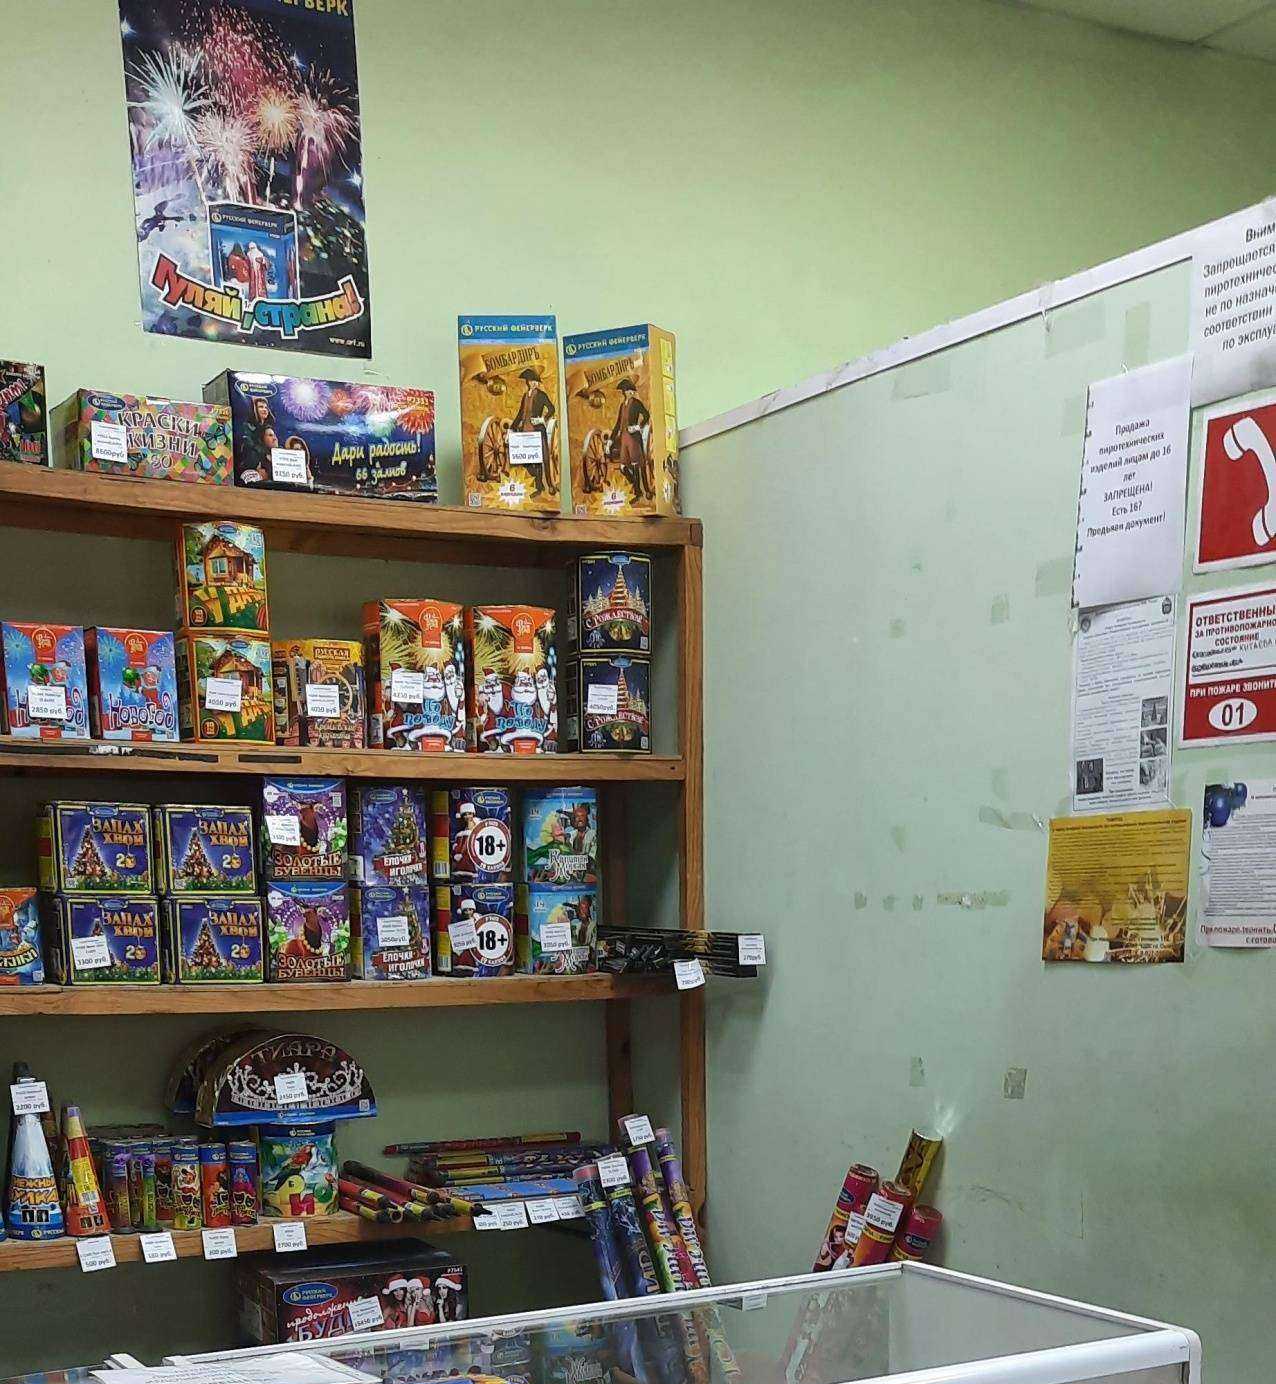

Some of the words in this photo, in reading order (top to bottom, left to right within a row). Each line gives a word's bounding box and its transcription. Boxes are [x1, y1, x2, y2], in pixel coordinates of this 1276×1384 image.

[1203, 244, 1276, 278] Запрещается
[152, 254, 254, 329] Гуляй,
[254, 280, 362, 336] страна!
[1205, 304, 1218, 317] не
[1220, 298, 1233, 313] по
[1203, 305, 1273, 338] соответствии
[1222, 337, 1235, 351] по
[116, 411, 201, 438] КРАСКИ
[1115, 419, 1150, 436] Продажа
[332, 441, 365, 466] Дари
[369, 429, 422, 466] радость!
[1099, 432, 1165, 456] пиротехнических
[1090, 459, 1123, 475] изделий
[1123, 453, 1150, 469] лицам
[1150, 450, 1161, 464] до
[1162, 445, 1172, 456] 16
[1123, 471, 1136, 482] лет
[1103, 481, 1153, 502] ЗАПРЕЩЕНА!
[1112, 506, 1128, 517] Есть
[1130, 502, 1142, 513] 16?
[1125, 511, 1166, 531] документ!
[1195, 629, 1204, 639] ЗА
[1214, 633, 1260, 647] СОСТОЯНИЕ
[1189, 688, 1207, 698] ПРИ
[1207, 684, 1240, 697] ПОЖАРЕ
[1221, 702, 1246, 727] 01
[93, 817, 144, 835] ЗАПАХ
[199, 818, 248, 836] ЗАПАХ
[476, 835, 506, 856] 18+
[273, 852, 343, 866] ЗОЛОТЫЕ
[102, 911, 154, 928] ЗАПАХ
[209, 911, 258, 927] ЗАПАХ
[477, 930, 507, 951] 18+
[278, 954, 345, 968] ЗОЛОТЫЕ
